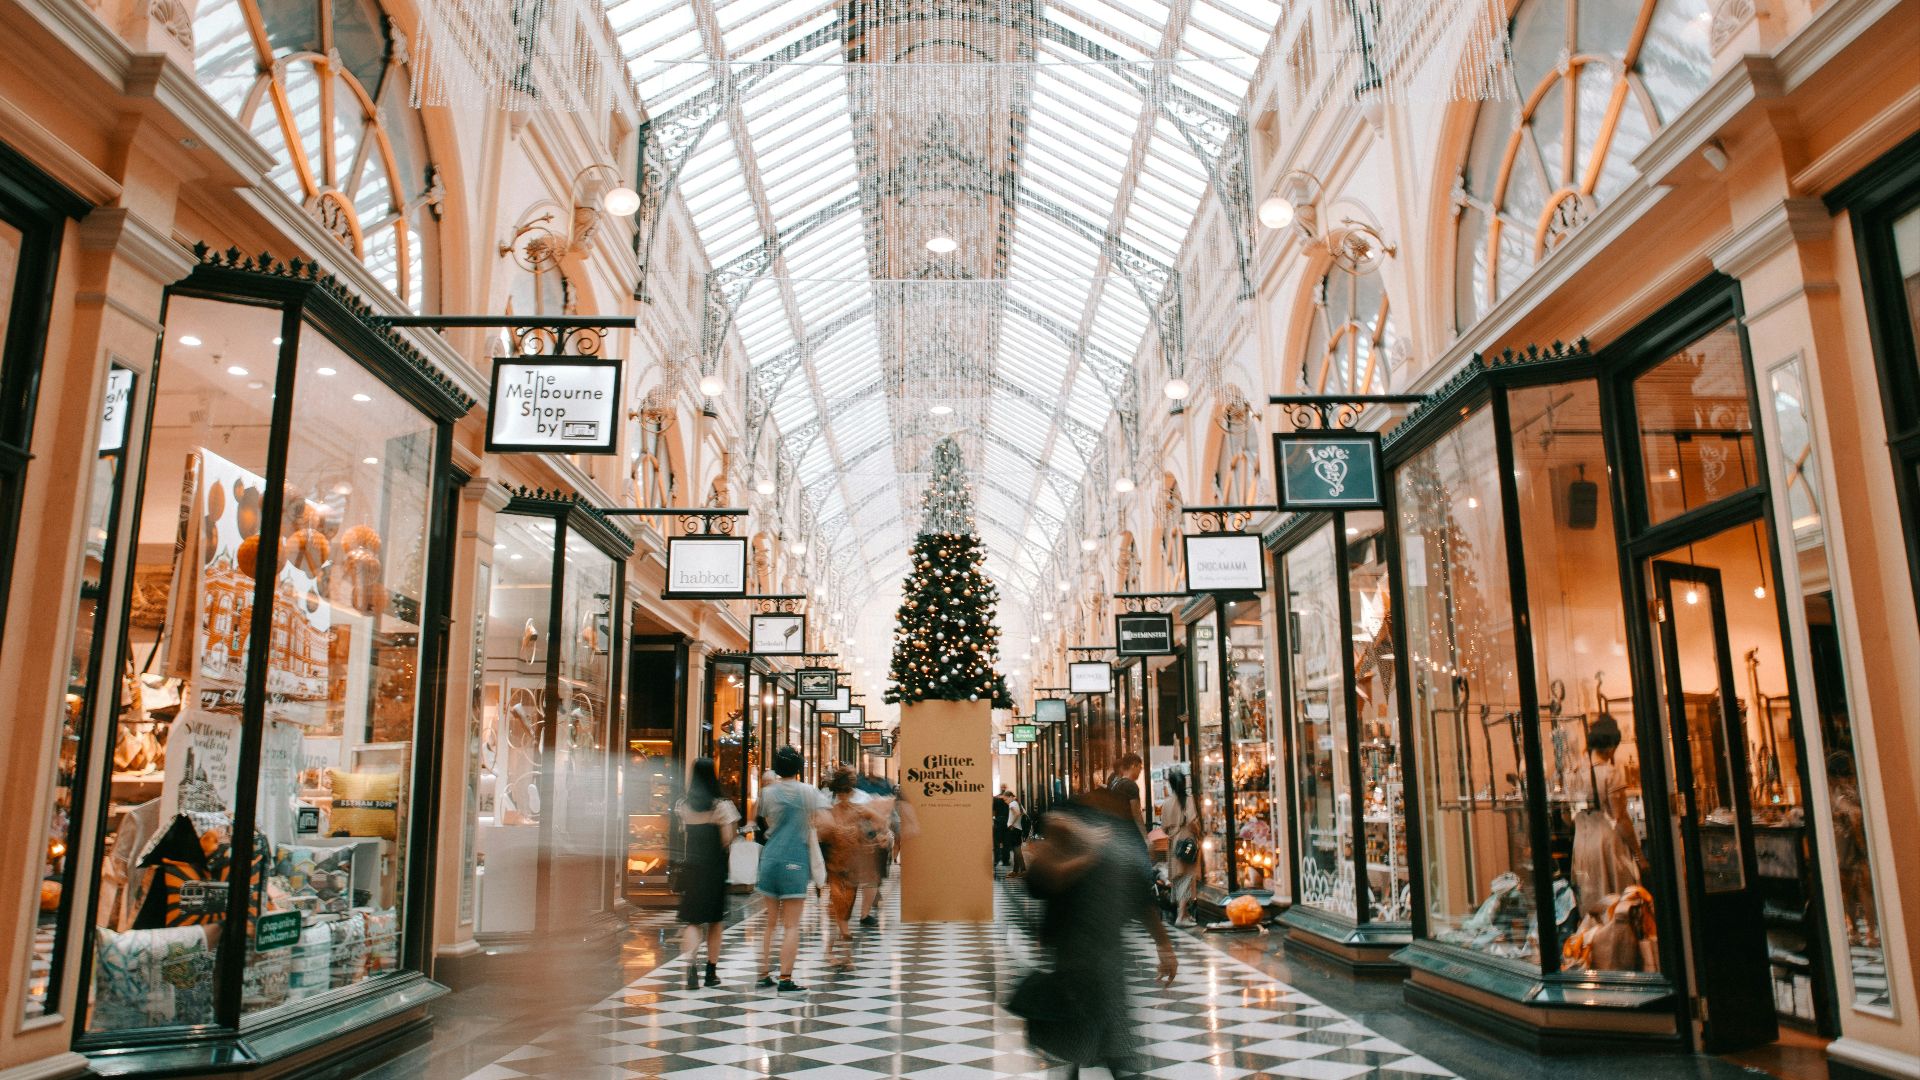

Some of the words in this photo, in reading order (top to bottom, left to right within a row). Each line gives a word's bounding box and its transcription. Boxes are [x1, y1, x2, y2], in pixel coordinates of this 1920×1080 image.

[525, 370, 557, 385] The
[506, 384, 604, 400] Melbourne
[521, 401, 566, 421] Shop
[537, 421, 559, 436] by
[907, 767, 963, 782] Sparkle
